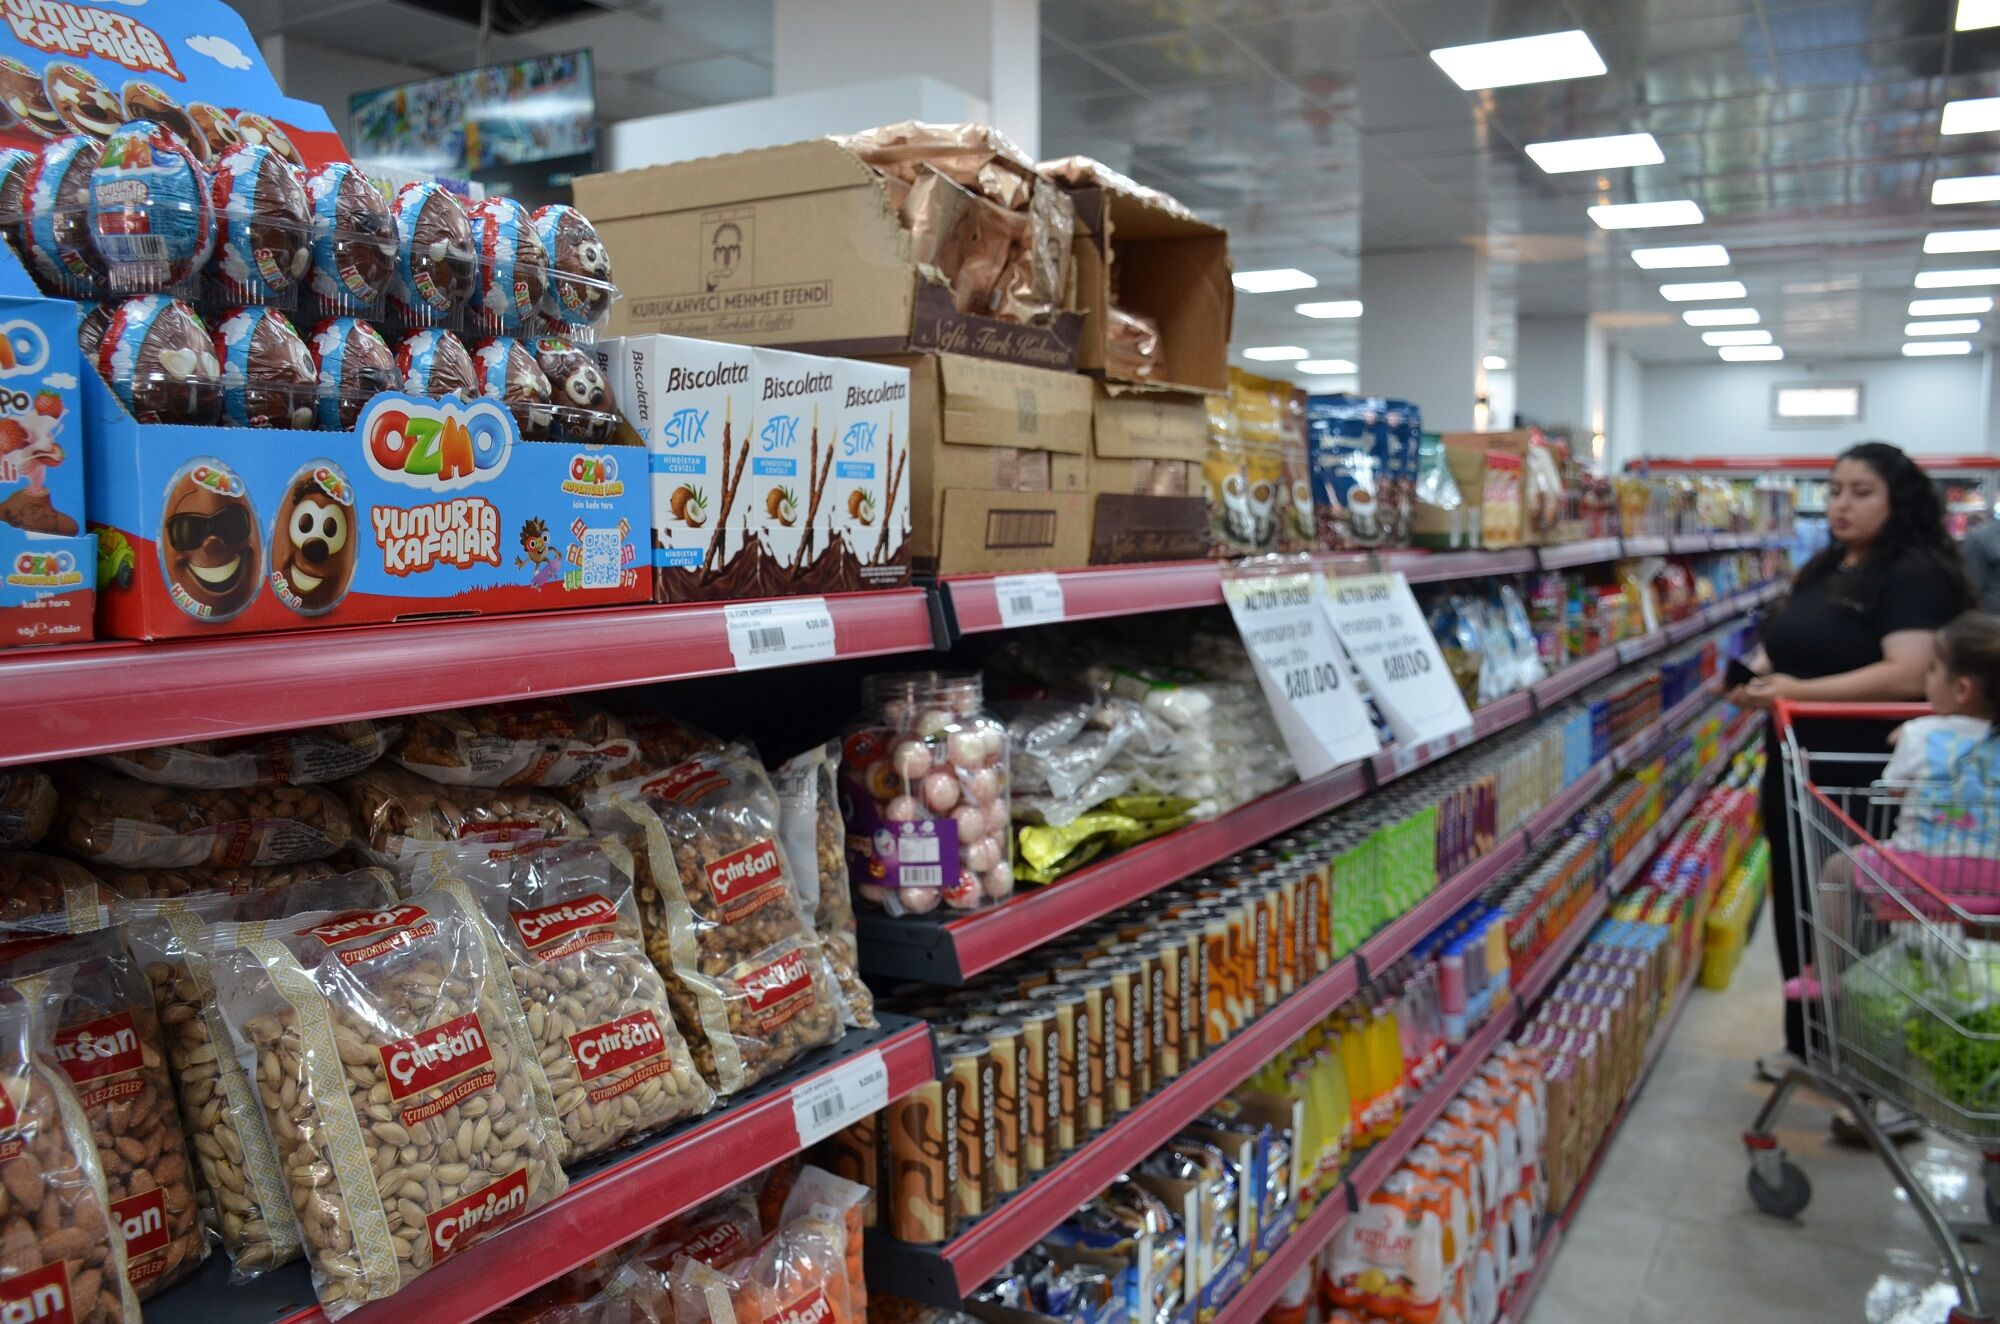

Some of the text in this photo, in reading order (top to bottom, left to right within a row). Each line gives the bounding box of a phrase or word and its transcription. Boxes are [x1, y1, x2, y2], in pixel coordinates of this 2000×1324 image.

[0, 0, 165, 54] UMURTA
[7, 13, 179, 77] KAFALAR
[631, 283, 829, 318] KURUKAHVECİ MEHMET EFENDİ
[632, 350, 649, 420] Biscolata
[666, 361, 750, 393] Biscolata
[762, 371, 833, 401] Biscolata
[845, 381, 906, 409] Biscolata
[371, 410, 504, 481] OZMO
[564, 480, 605, 497] ADVENTURE
[571, 457, 617, 484] OZMO
[372, 498, 497, 541] YUMURTA
[386, 525, 499, 570] KAFALAR
[271, 571, 303, 609] SÜSLÜ
[712, 850, 777, 895] Çıtırşan
[518, 900, 610, 940] Çıtırşan
[390, 1026, 483, 1086] Çıtırşan
[578, 1022, 660, 1070] Çıtırşan
[435, 1184, 525, 1251] Çıtırşan
